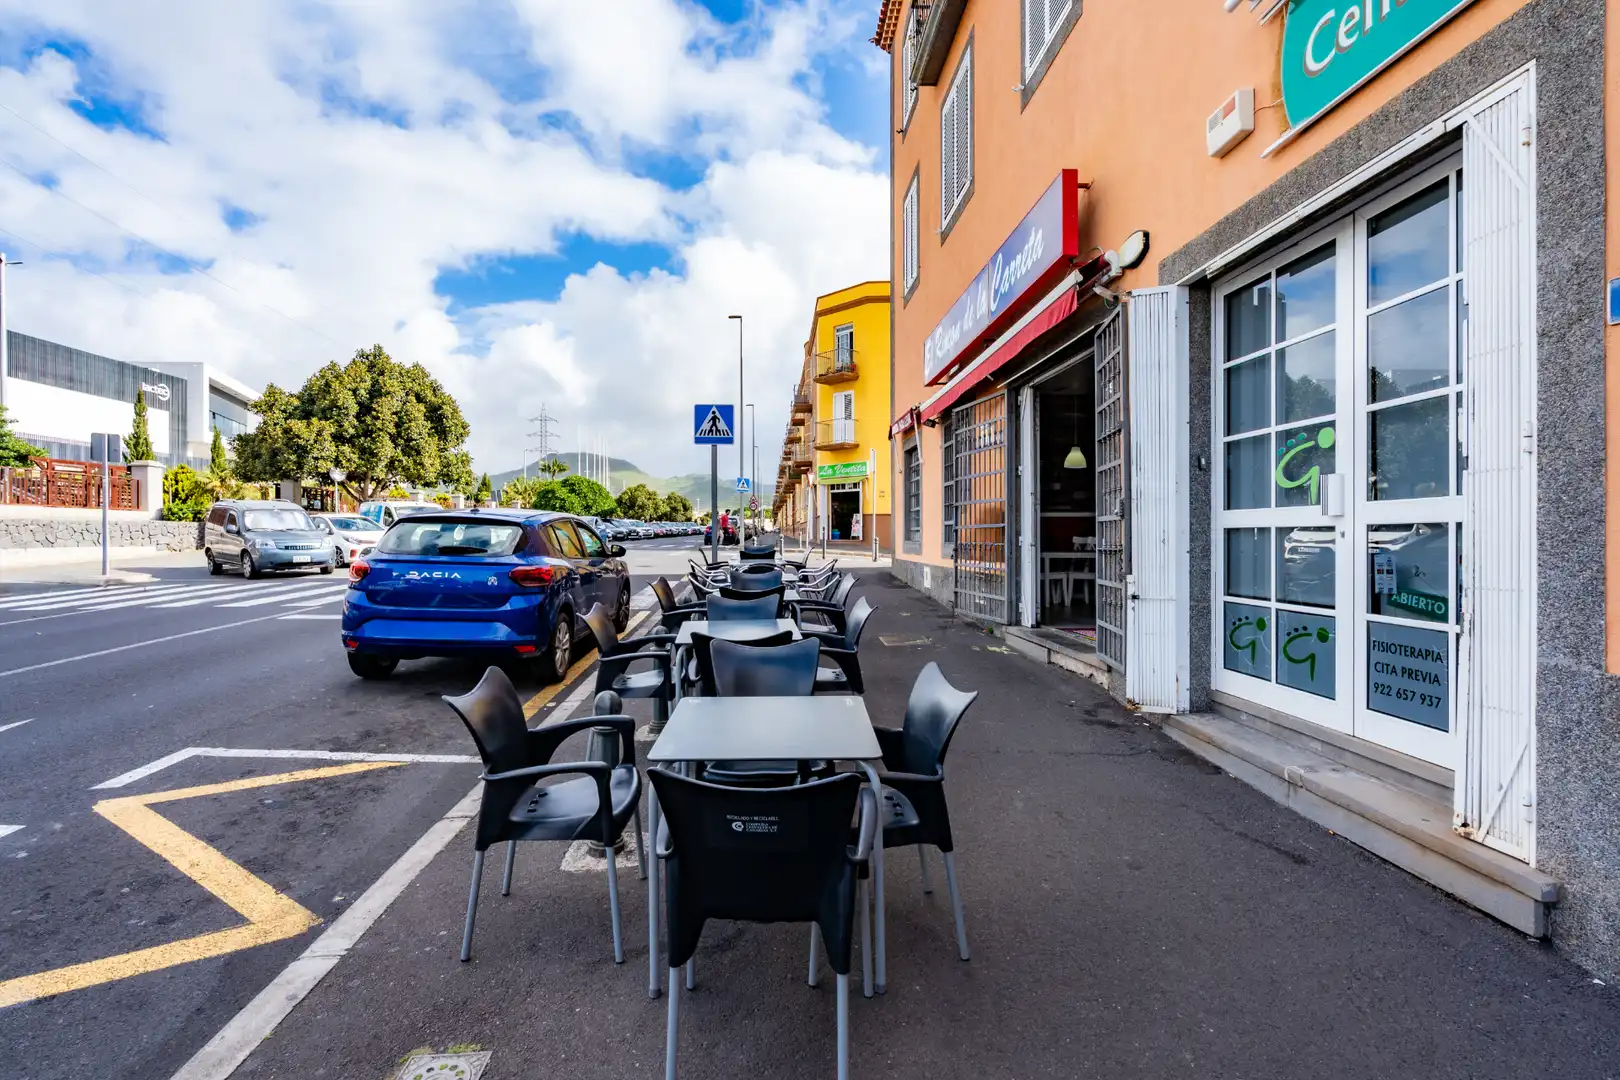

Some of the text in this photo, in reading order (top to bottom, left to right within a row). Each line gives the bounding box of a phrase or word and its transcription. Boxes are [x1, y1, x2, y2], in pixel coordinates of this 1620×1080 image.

[1304, 0, 1408, 77] Cen
[963, 295, 974, 332] de
[976, 281, 987, 320] la
[990, 226, 1045, 312] Carreta
[819, 465, 833, 475] La
[408, 570, 462, 579] DACIA
[1391, 592, 1446, 614] ABIERTO
[1372, 639, 1444, 664] FISIOTERAPIA
[1374, 661, 1441, 686] CITA PREVIA
[1373, 682, 1442, 709] 922 657 937
